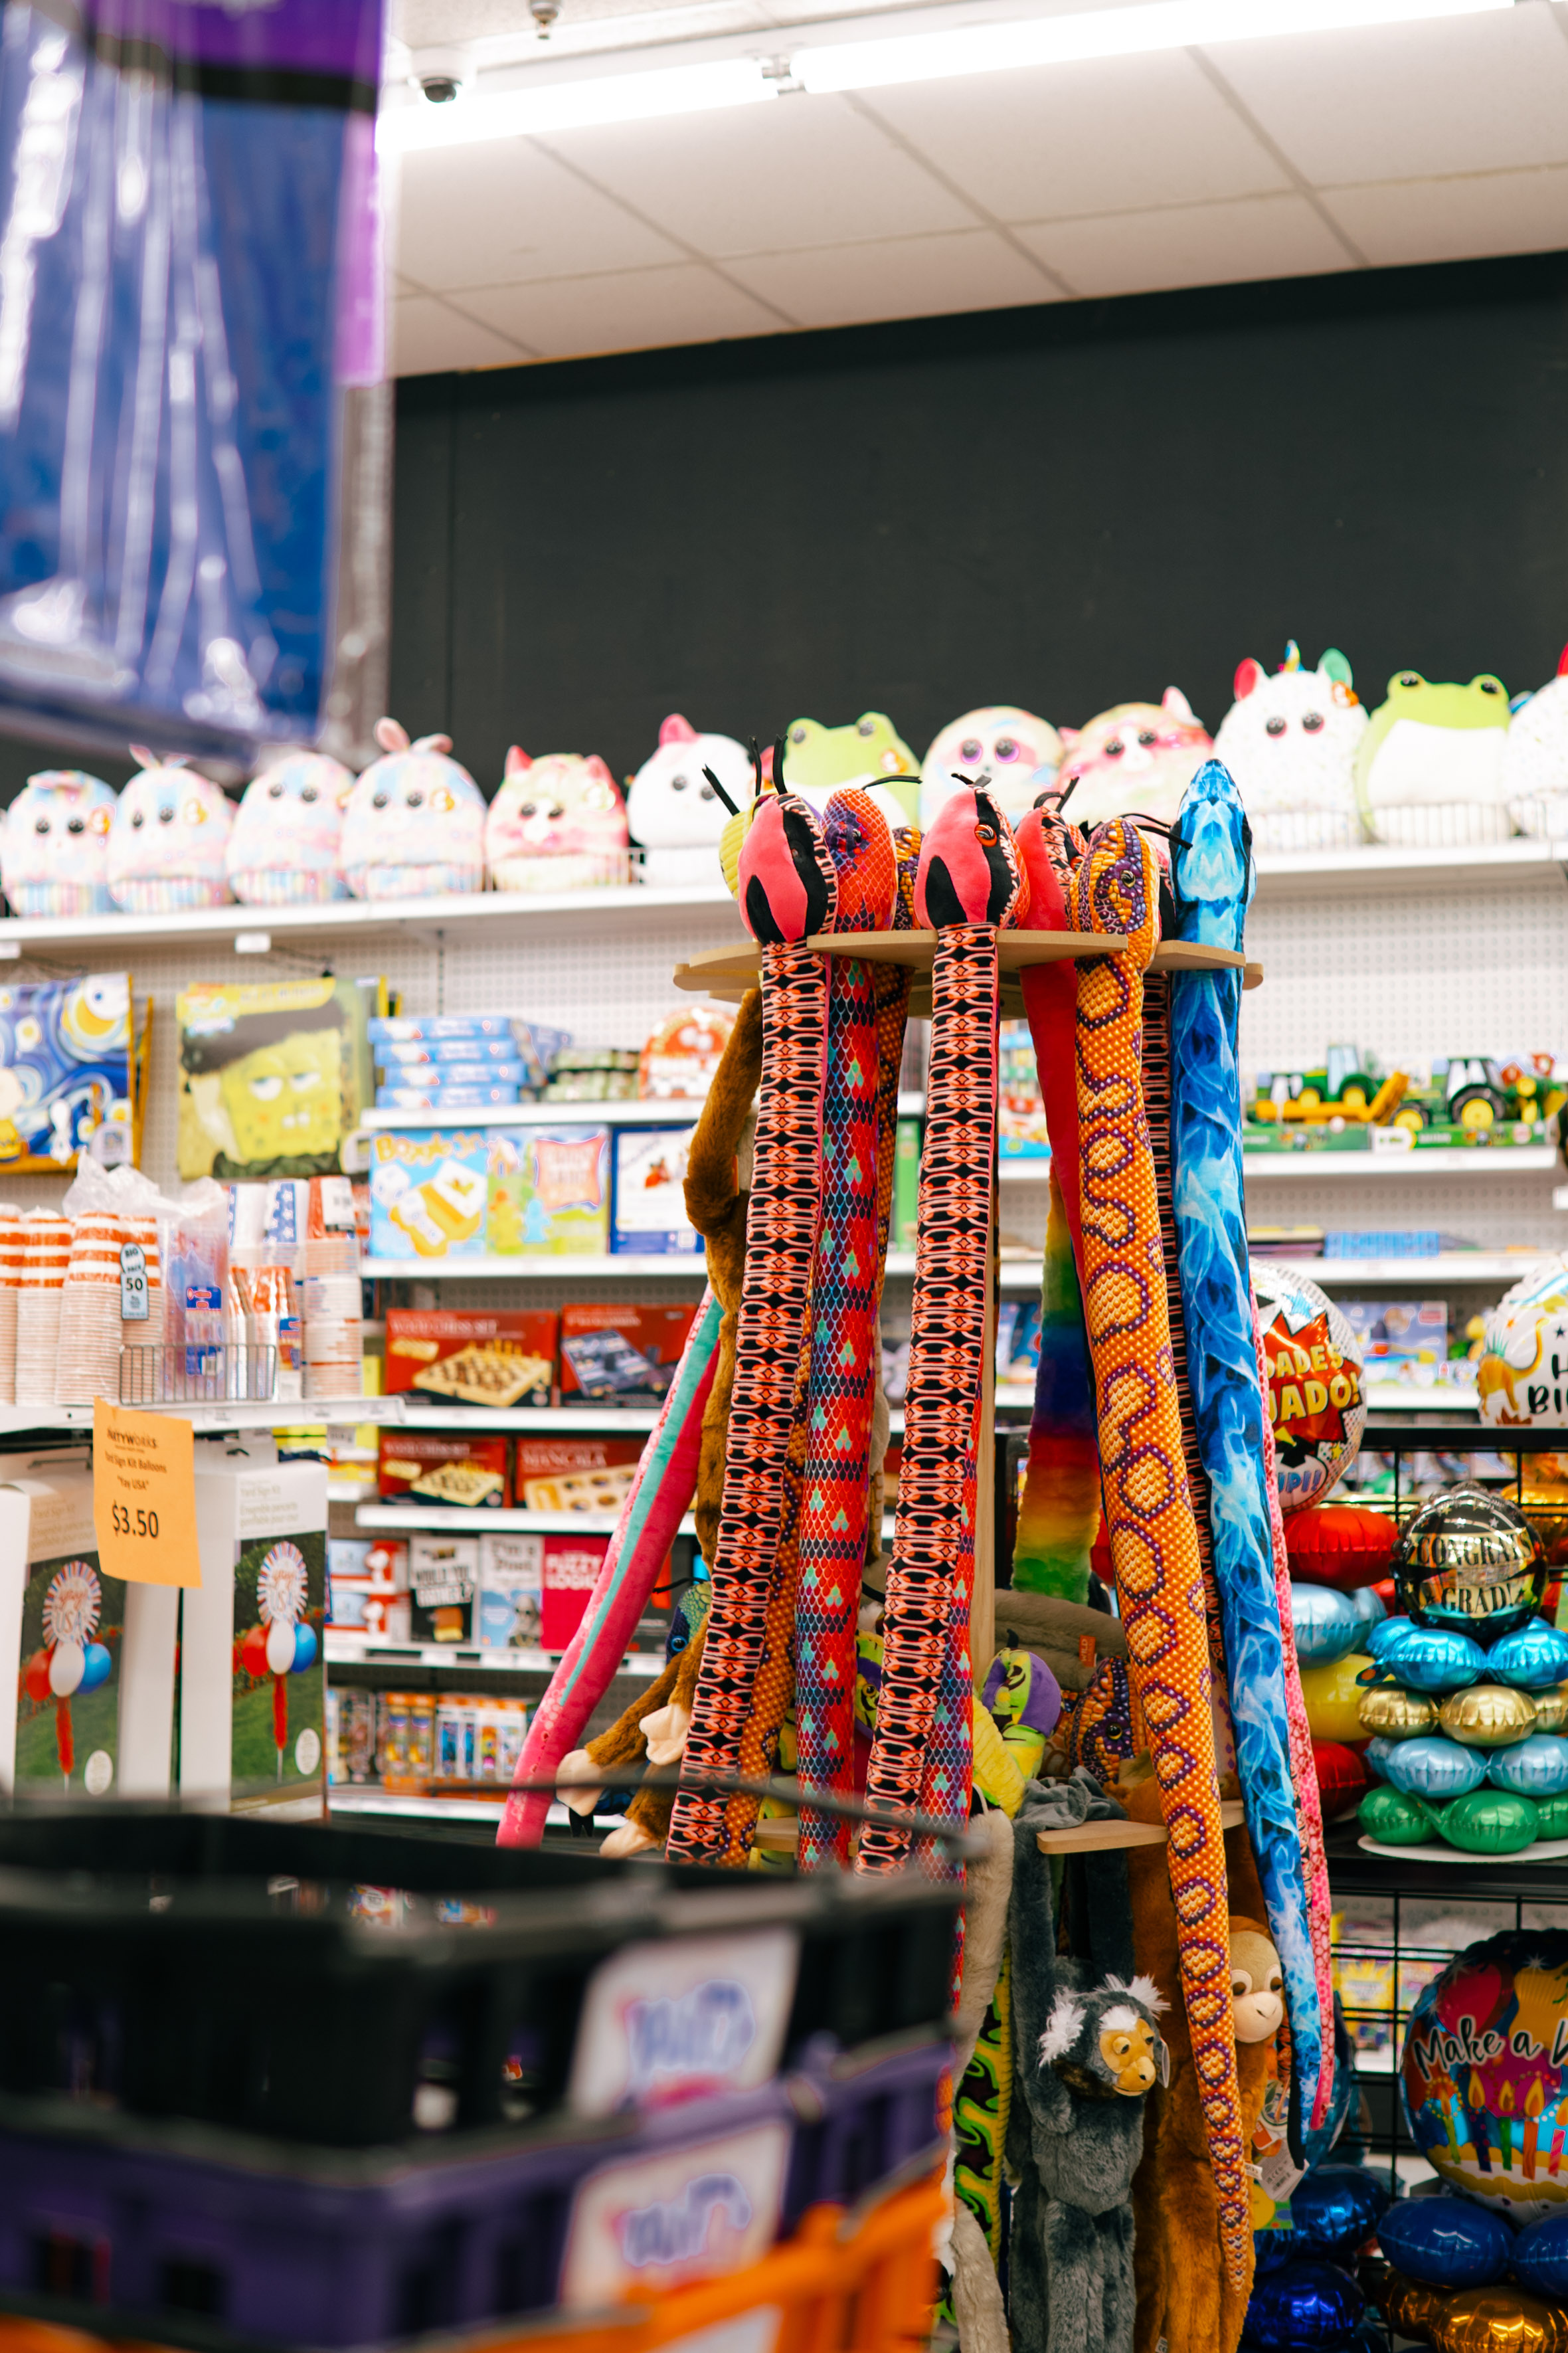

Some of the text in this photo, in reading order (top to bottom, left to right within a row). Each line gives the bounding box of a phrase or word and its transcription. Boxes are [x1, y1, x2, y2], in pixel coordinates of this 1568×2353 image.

[126, 1277, 143, 1291] 50
[112, 1499, 159, 1539] $3.50
[1417, 1533, 1533, 1566] CONGRATS
[1440, 1582, 1515, 1614] GRAD!
[1413, 2017, 1502, 2082] Make
[1513, 2031, 1540, 2057] a
